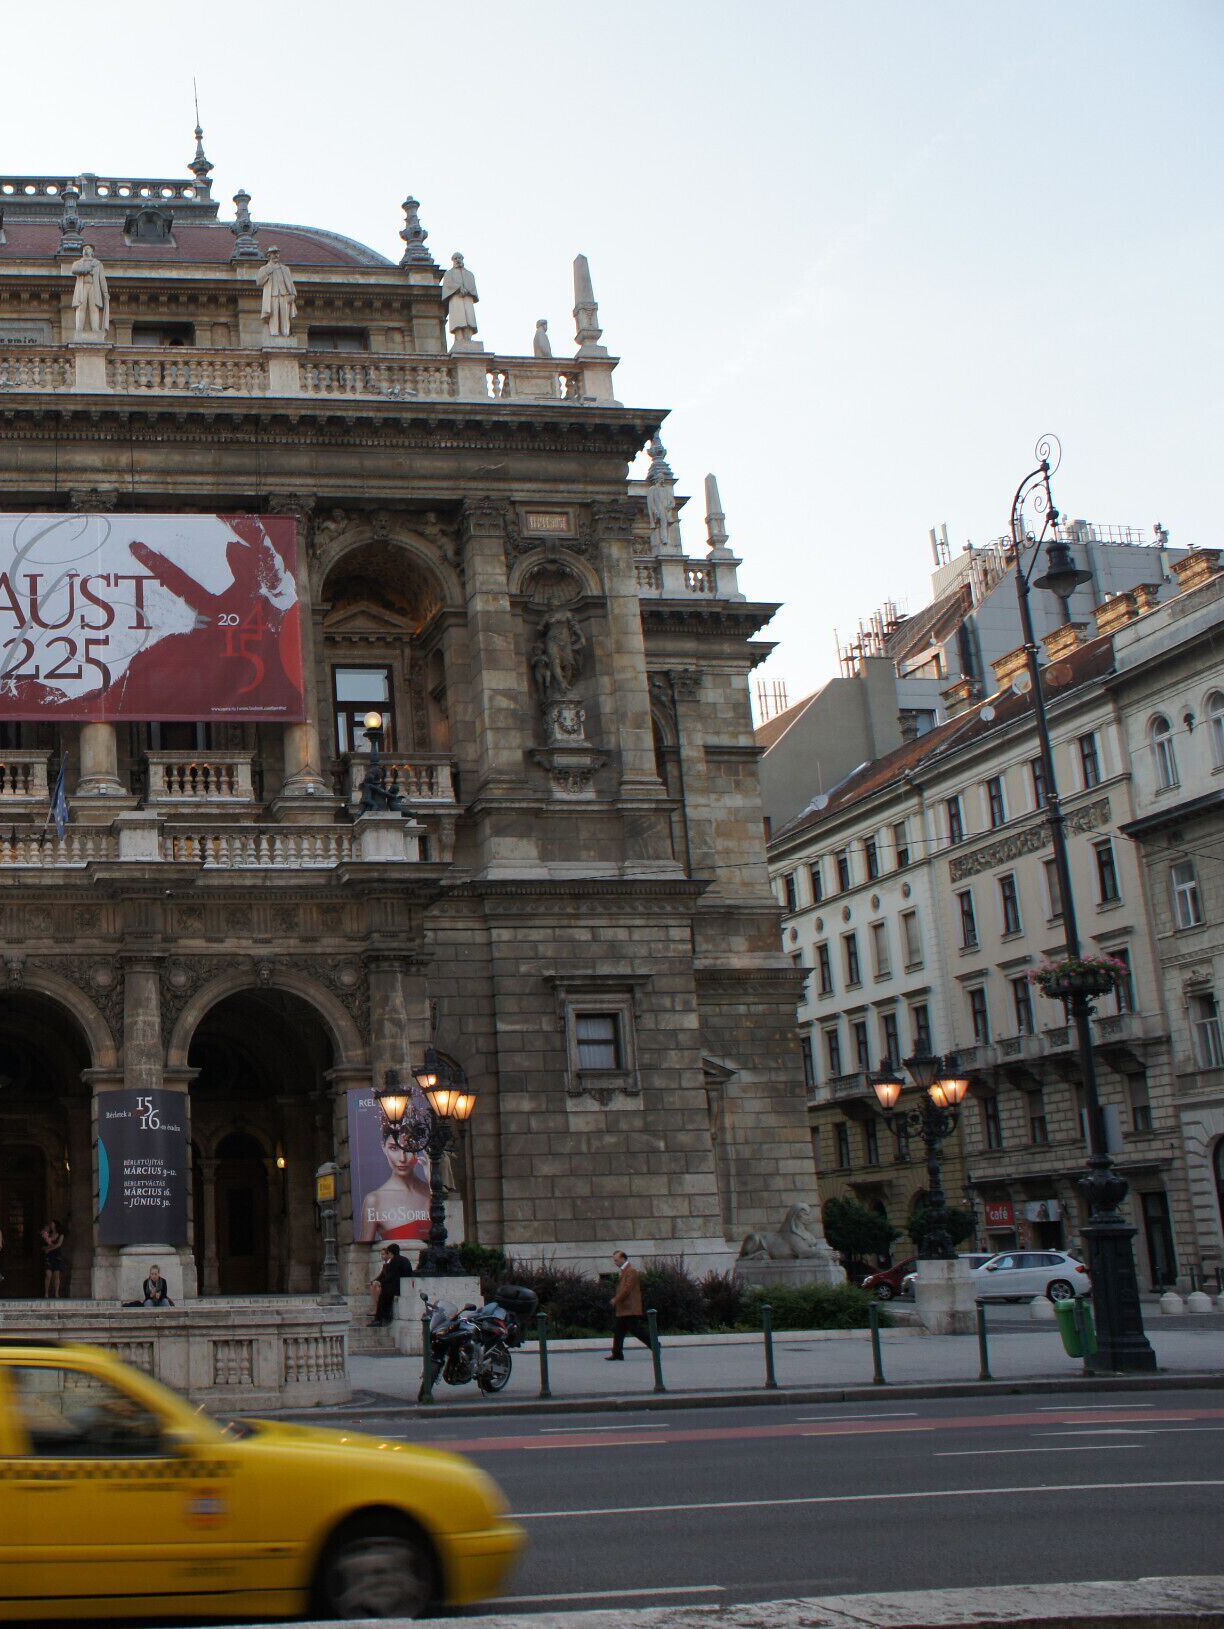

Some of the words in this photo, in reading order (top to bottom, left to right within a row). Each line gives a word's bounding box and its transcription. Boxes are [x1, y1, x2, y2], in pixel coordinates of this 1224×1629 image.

[218, 614, 240, 626] 20
[0, 634, 112, 700] 225
[136, 1096, 153, 1117] 15
[139, 1110, 160, 1129] 16
[124, 1166, 162, 1175] MÁRCIUS
[124, 1187, 162, 1196] MÁRCIUS
[163, 1188, 172, 1196] 16.
[129, 1197, 161, 1207] JÚNIUS
[990, 1207, 1008, 1220] café
